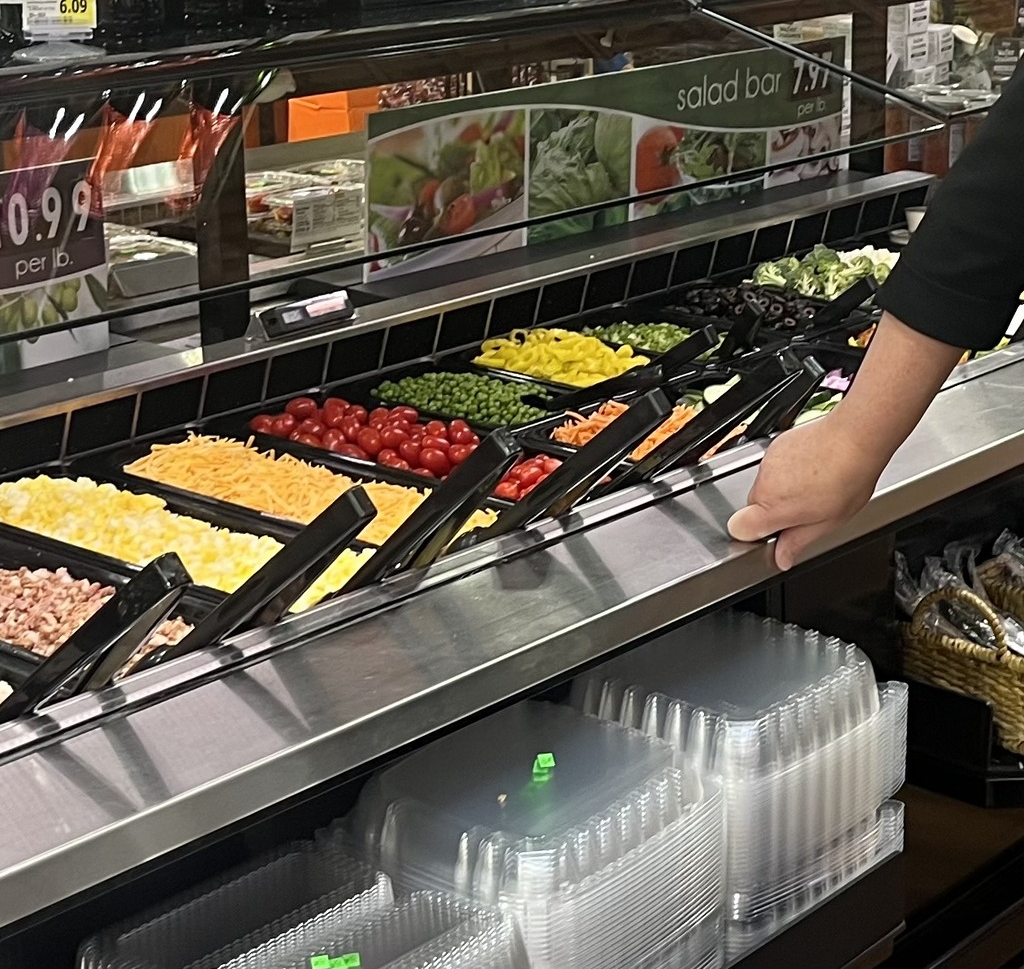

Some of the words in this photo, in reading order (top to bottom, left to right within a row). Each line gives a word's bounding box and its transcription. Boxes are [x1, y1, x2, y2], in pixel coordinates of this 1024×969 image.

[677, 68, 739, 112] salad
[745, 66, 782, 99] bar
[792, 51, 833, 95] 7.97
[797, 102, 814, 118] per
[0, 179, 92, 246] 0.99
[15, 256, 46, 281] per
[52, 246, 74, 268] lb.
